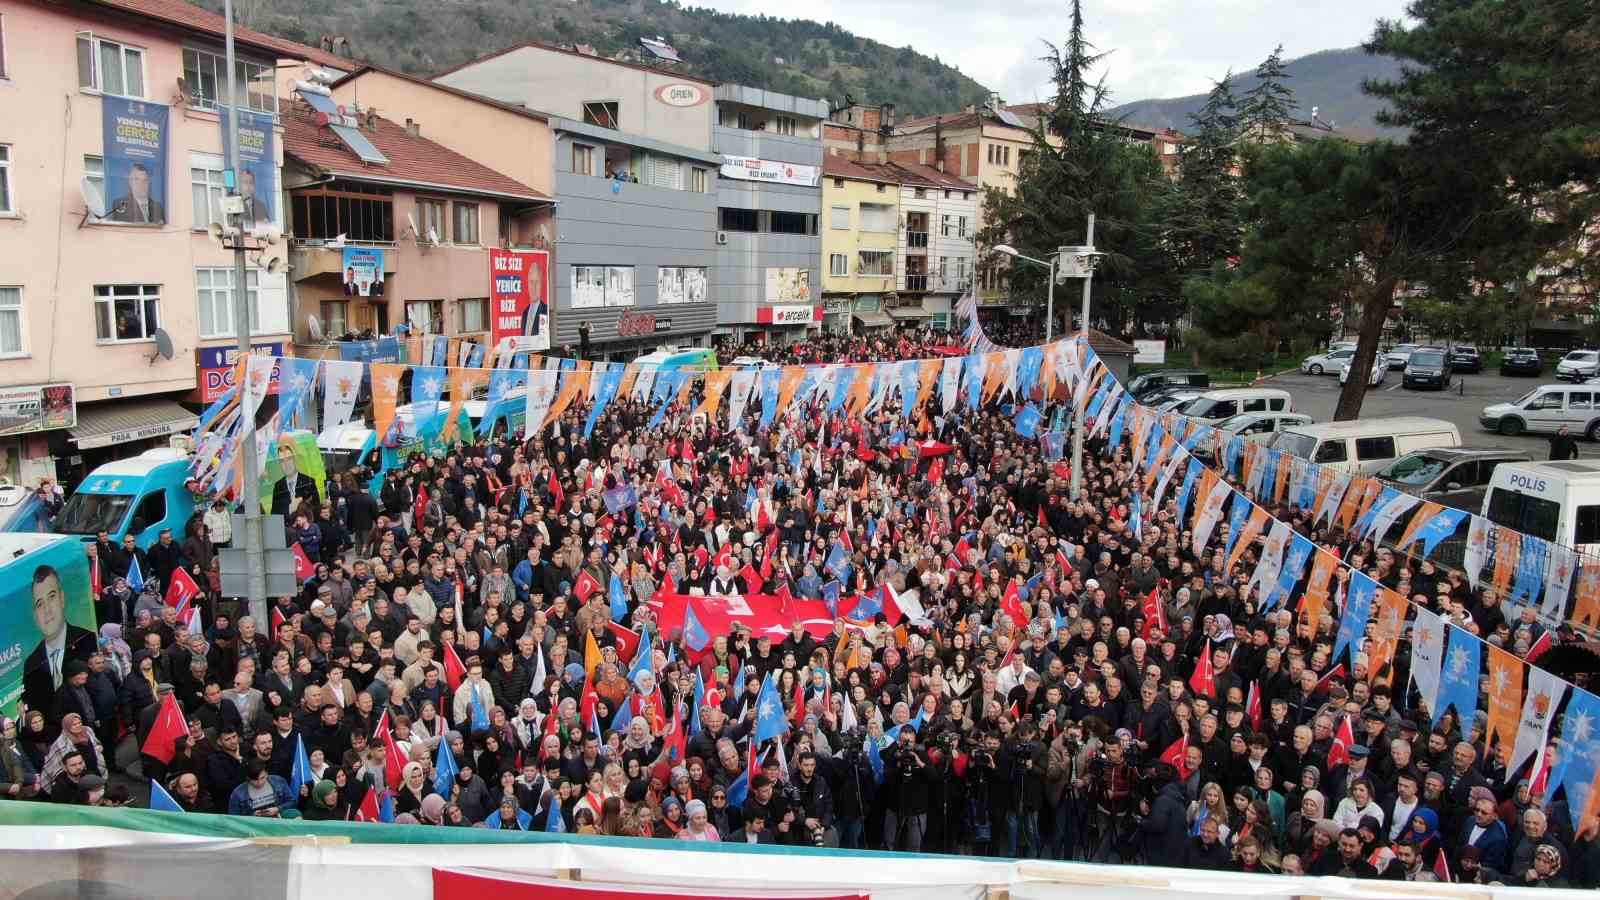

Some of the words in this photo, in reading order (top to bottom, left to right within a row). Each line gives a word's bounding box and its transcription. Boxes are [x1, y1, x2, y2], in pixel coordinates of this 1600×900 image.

[495, 254, 507, 270] BİZ
[508, 254, 522, 271] SİZE
[497, 275, 521, 293] YENİCE
[500, 296, 516, 313] BİZE
[1511, 474, 1546, 492] POLİS
